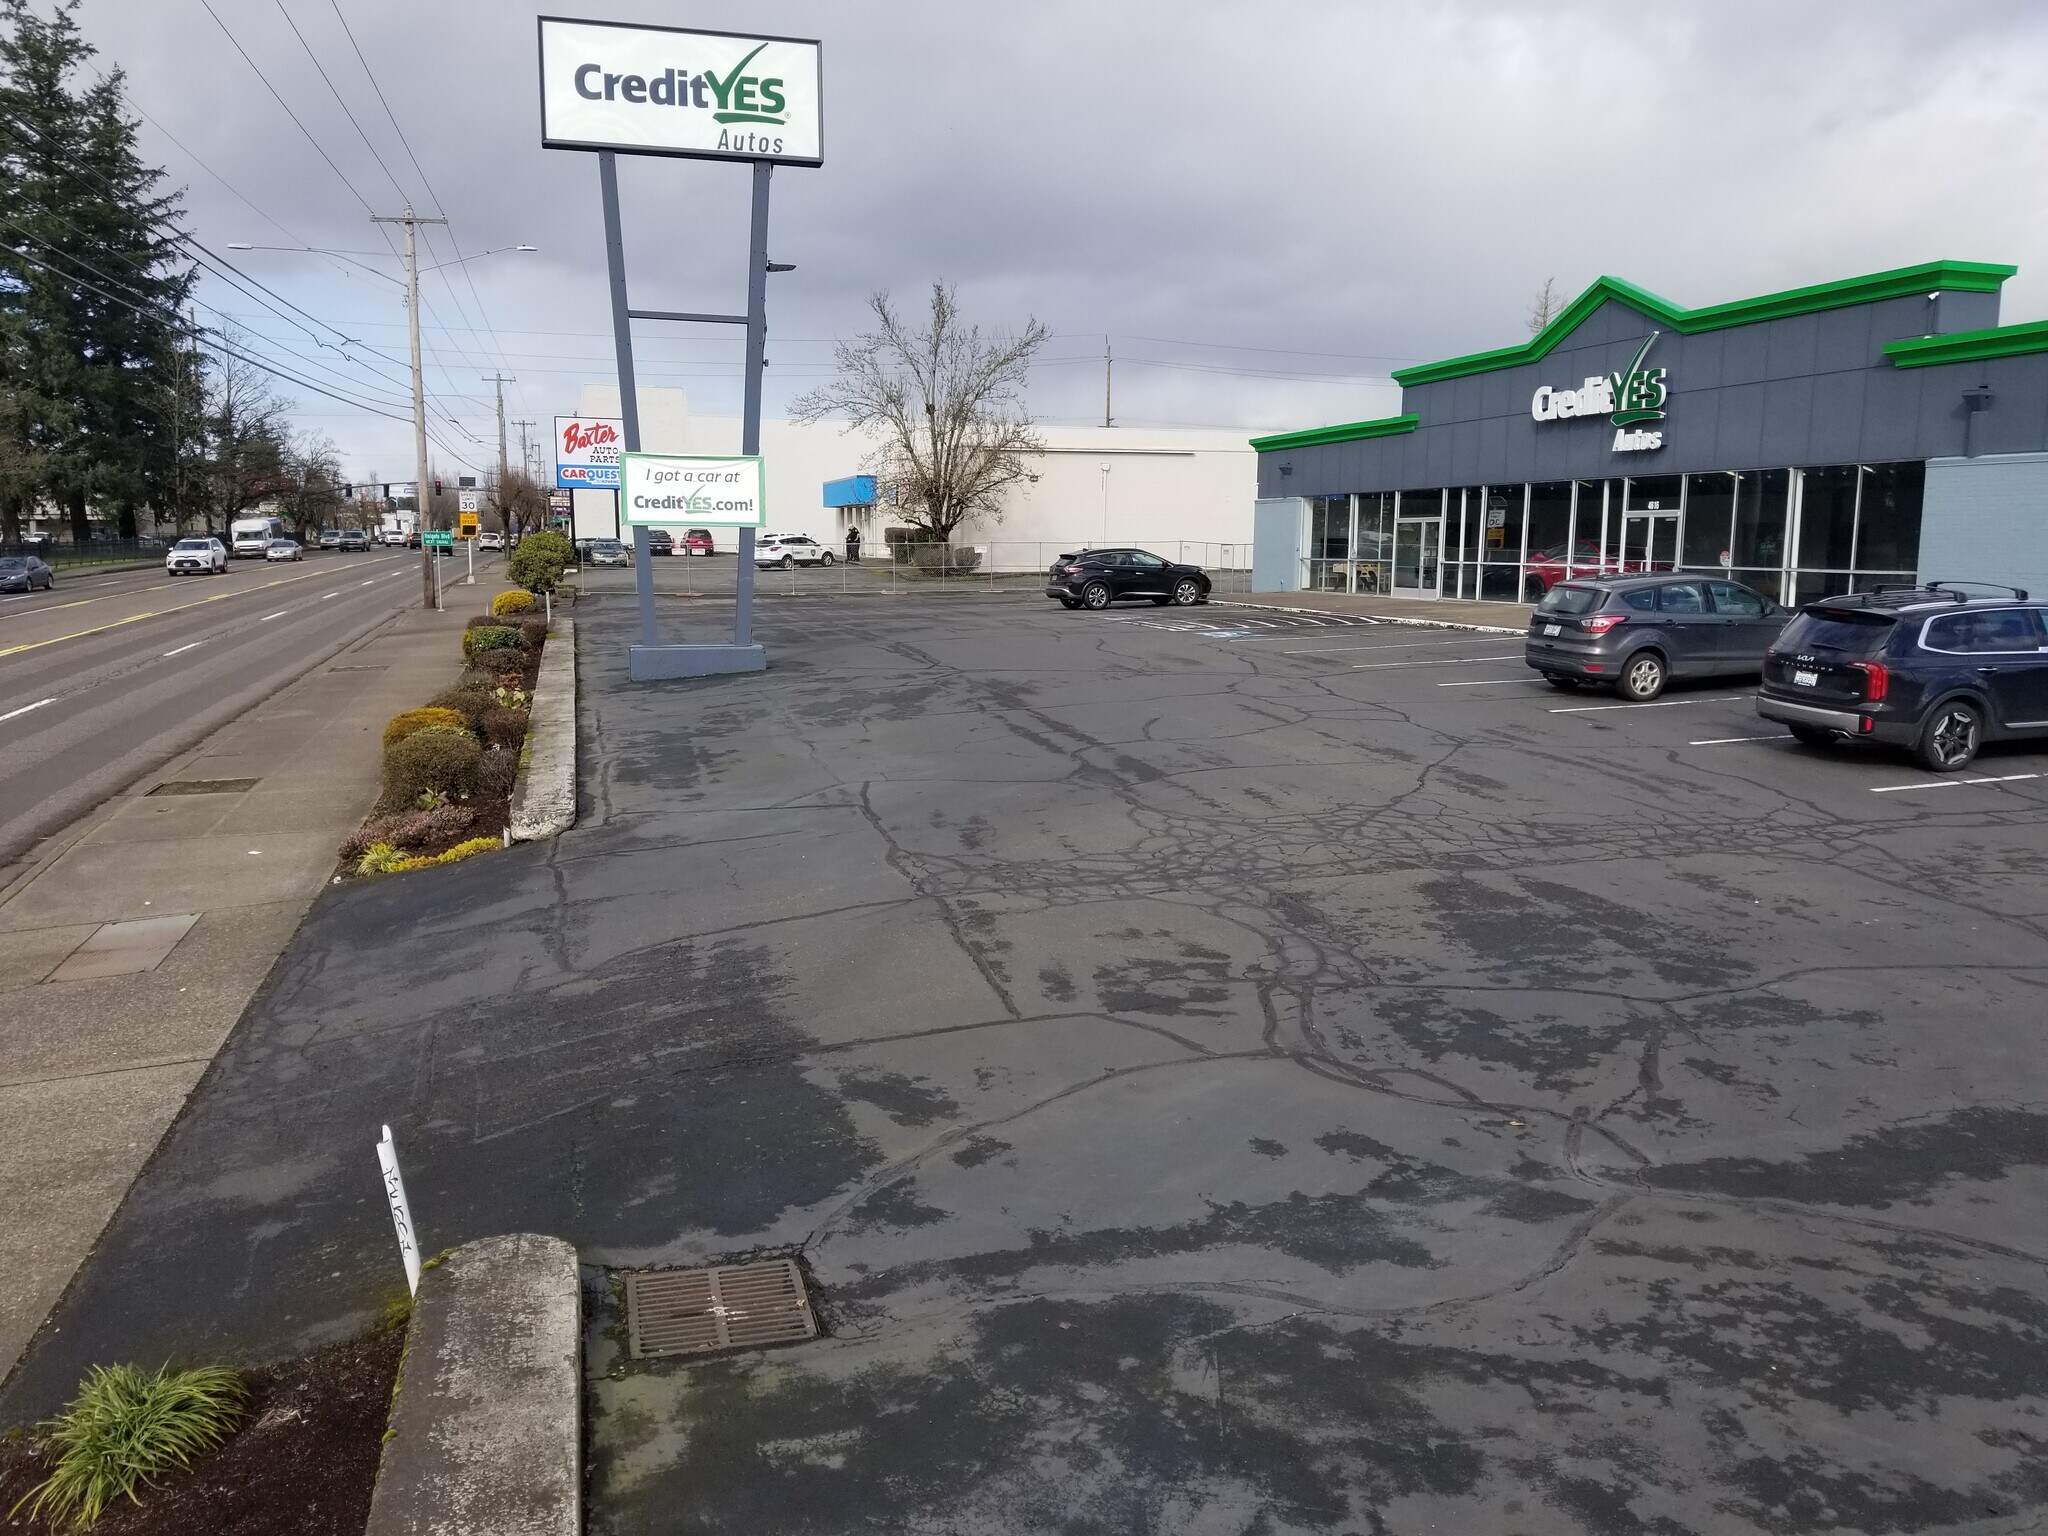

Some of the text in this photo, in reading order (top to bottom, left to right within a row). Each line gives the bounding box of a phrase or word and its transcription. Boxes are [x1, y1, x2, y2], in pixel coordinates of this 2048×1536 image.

[574, 42, 786, 114] CreditYES
[717, 128, 784, 154] Autos
[1532, 331, 1667, 421] CreditYES
[563, 422, 620, 454] Baxter
[592, 446, 619, 455] AUTO
[1612, 429, 1663, 451] Autos
[646, 468, 741, 484] I got a car at
[462, 501, 475, 509] 30
[634, 484, 753, 511] CreditYES.com!
